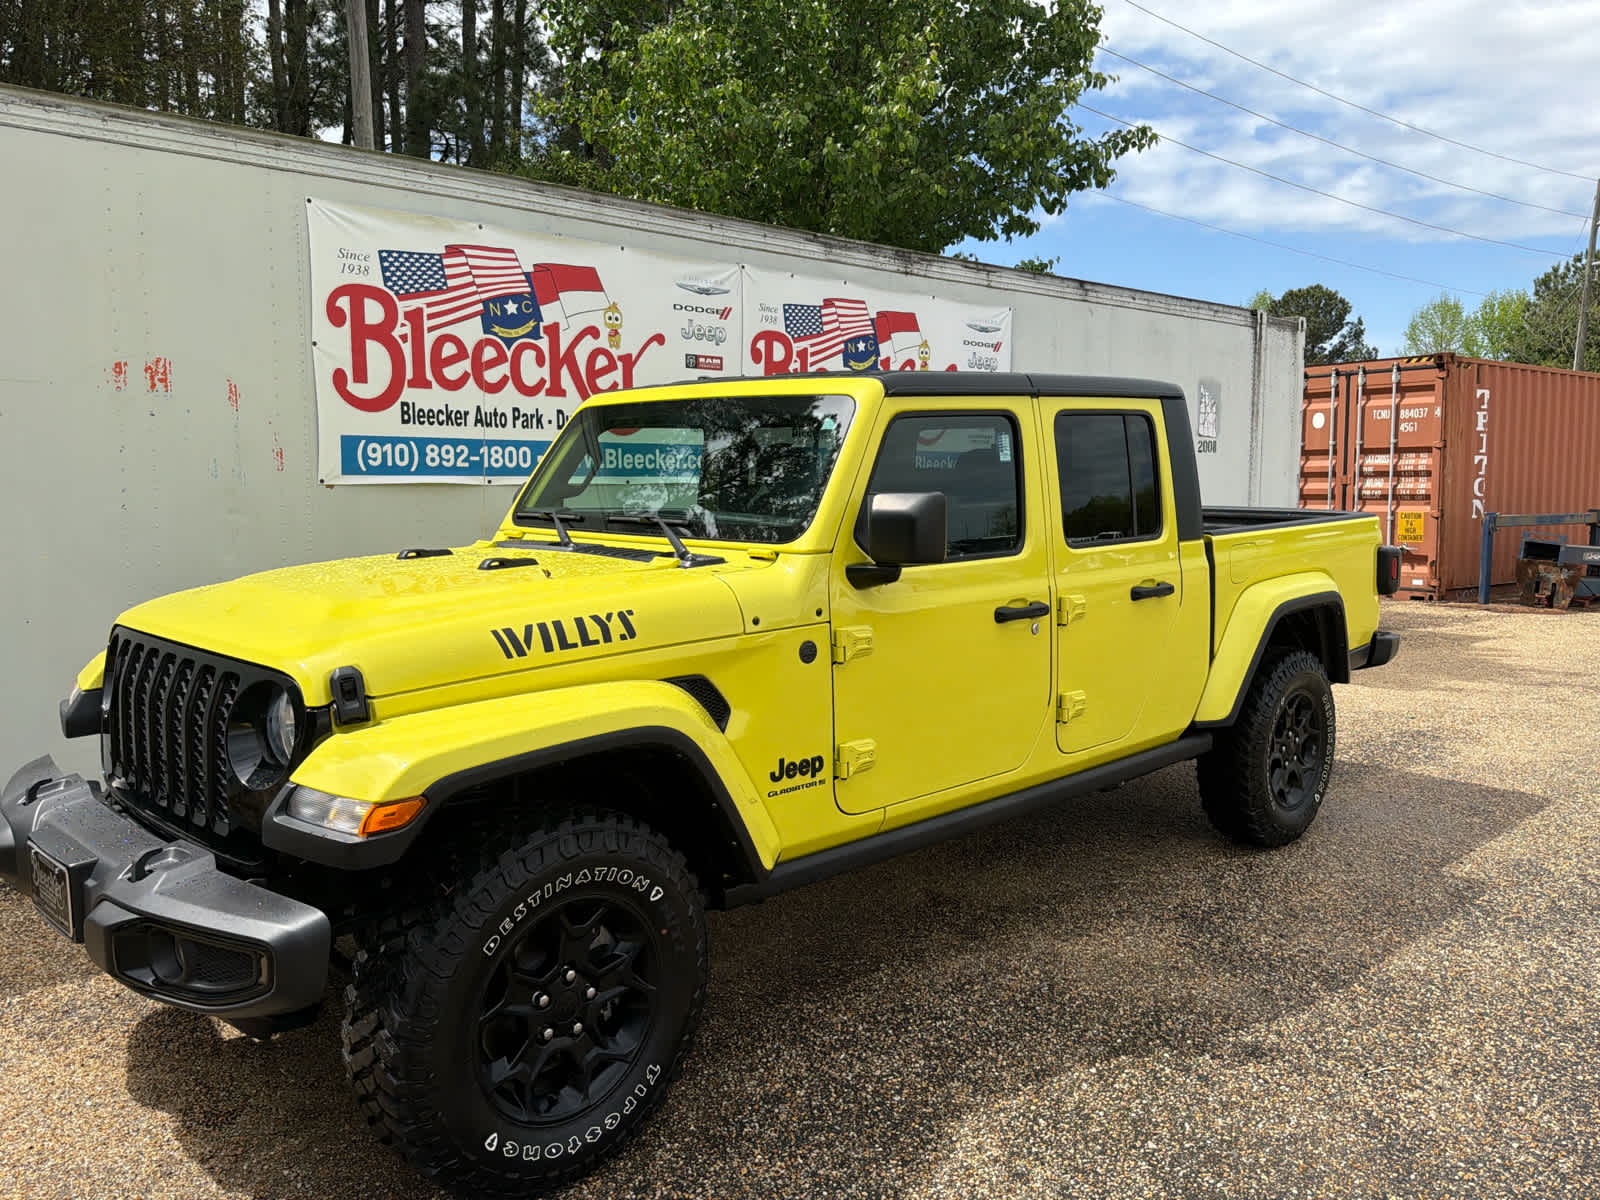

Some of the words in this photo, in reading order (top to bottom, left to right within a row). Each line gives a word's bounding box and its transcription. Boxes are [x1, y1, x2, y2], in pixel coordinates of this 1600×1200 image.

[337, 247, 370, 261] Since
[340, 263, 370, 276] 1938
[673, 303, 724, 315] DODGE
[759, 302, 779, 314] Since
[680, 318, 728, 346] Jeep
[326, 284, 666, 412] Bleecker
[967, 351, 999, 373] Jeep
[400, 401, 470, 427] Bleecker
[474, 404, 508, 428] Auto
[512, 407, 544, 429] Park
[1372, 408, 1391, 420] TCNU
[1399, 407, 1429, 420] 884037
[1399, 421, 1418, 433] 45G1
[357, 439, 419, 472] (910)
[425, 443, 532, 468] 892-1800
[1471, 388, 1490, 519] TRITON
[490, 609, 637, 659] WILLYS
[769, 755, 824, 783] Jeep
[483, 867, 650, 956] DESTINATION
